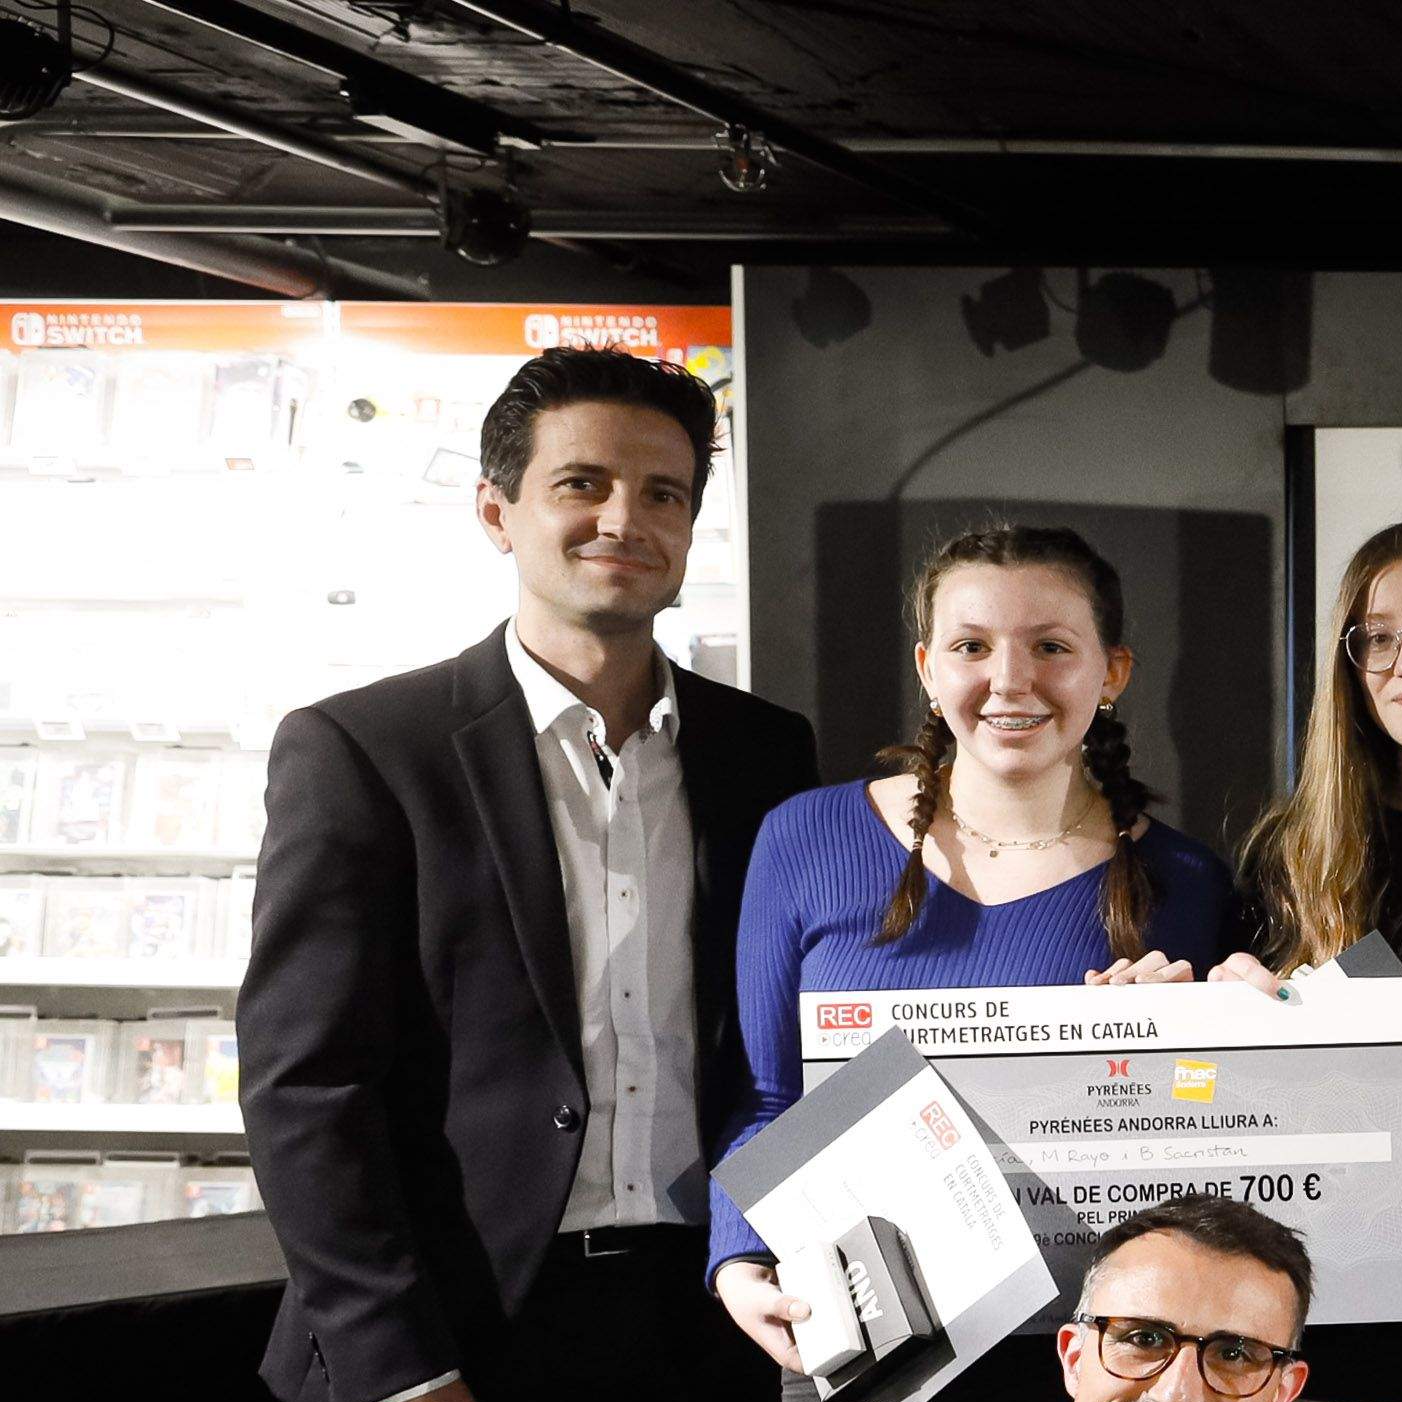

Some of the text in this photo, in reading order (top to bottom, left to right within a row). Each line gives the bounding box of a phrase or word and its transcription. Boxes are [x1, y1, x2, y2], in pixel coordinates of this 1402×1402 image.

[46, 313, 142, 326] NINTENDO
[560, 315, 658, 328] NINTENDO
[46, 326, 143, 345] SWITCH
[559, 328, 658, 349] SWITCH
[818, 1005, 872, 1028] REC
[892, 1002, 1009, 1020] CONCURS DE
[832, 1030, 872, 1047] crea
[899, 1018, 1158, 1045] URTMETRATGES EN CATALÀ
[1096, 1099, 1140, 1107] ANDORRA
[922, 1101, 960, 1150] REC
[1030, 1113, 1278, 1134] PYRÉNÉES ANDORRA LLIURA A:
[1043, 1150, 1059, 1162] M
[1068, 1149, 1110, 1168] Rayo
[1027, 1187, 1067, 1205] VAL
[1074, 1186, 1101, 1204] DE
[1107, 1182, 1198, 1203] COMPRA
[1205, 1181, 1232, 1200] DE
[1239, 1173, 1294, 1204] 700
[1303, 1172, 1321, 1200] €
[1077, 1210, 1137, 1224] PEL PRI
[847, 1260, 884, 1323] AND
